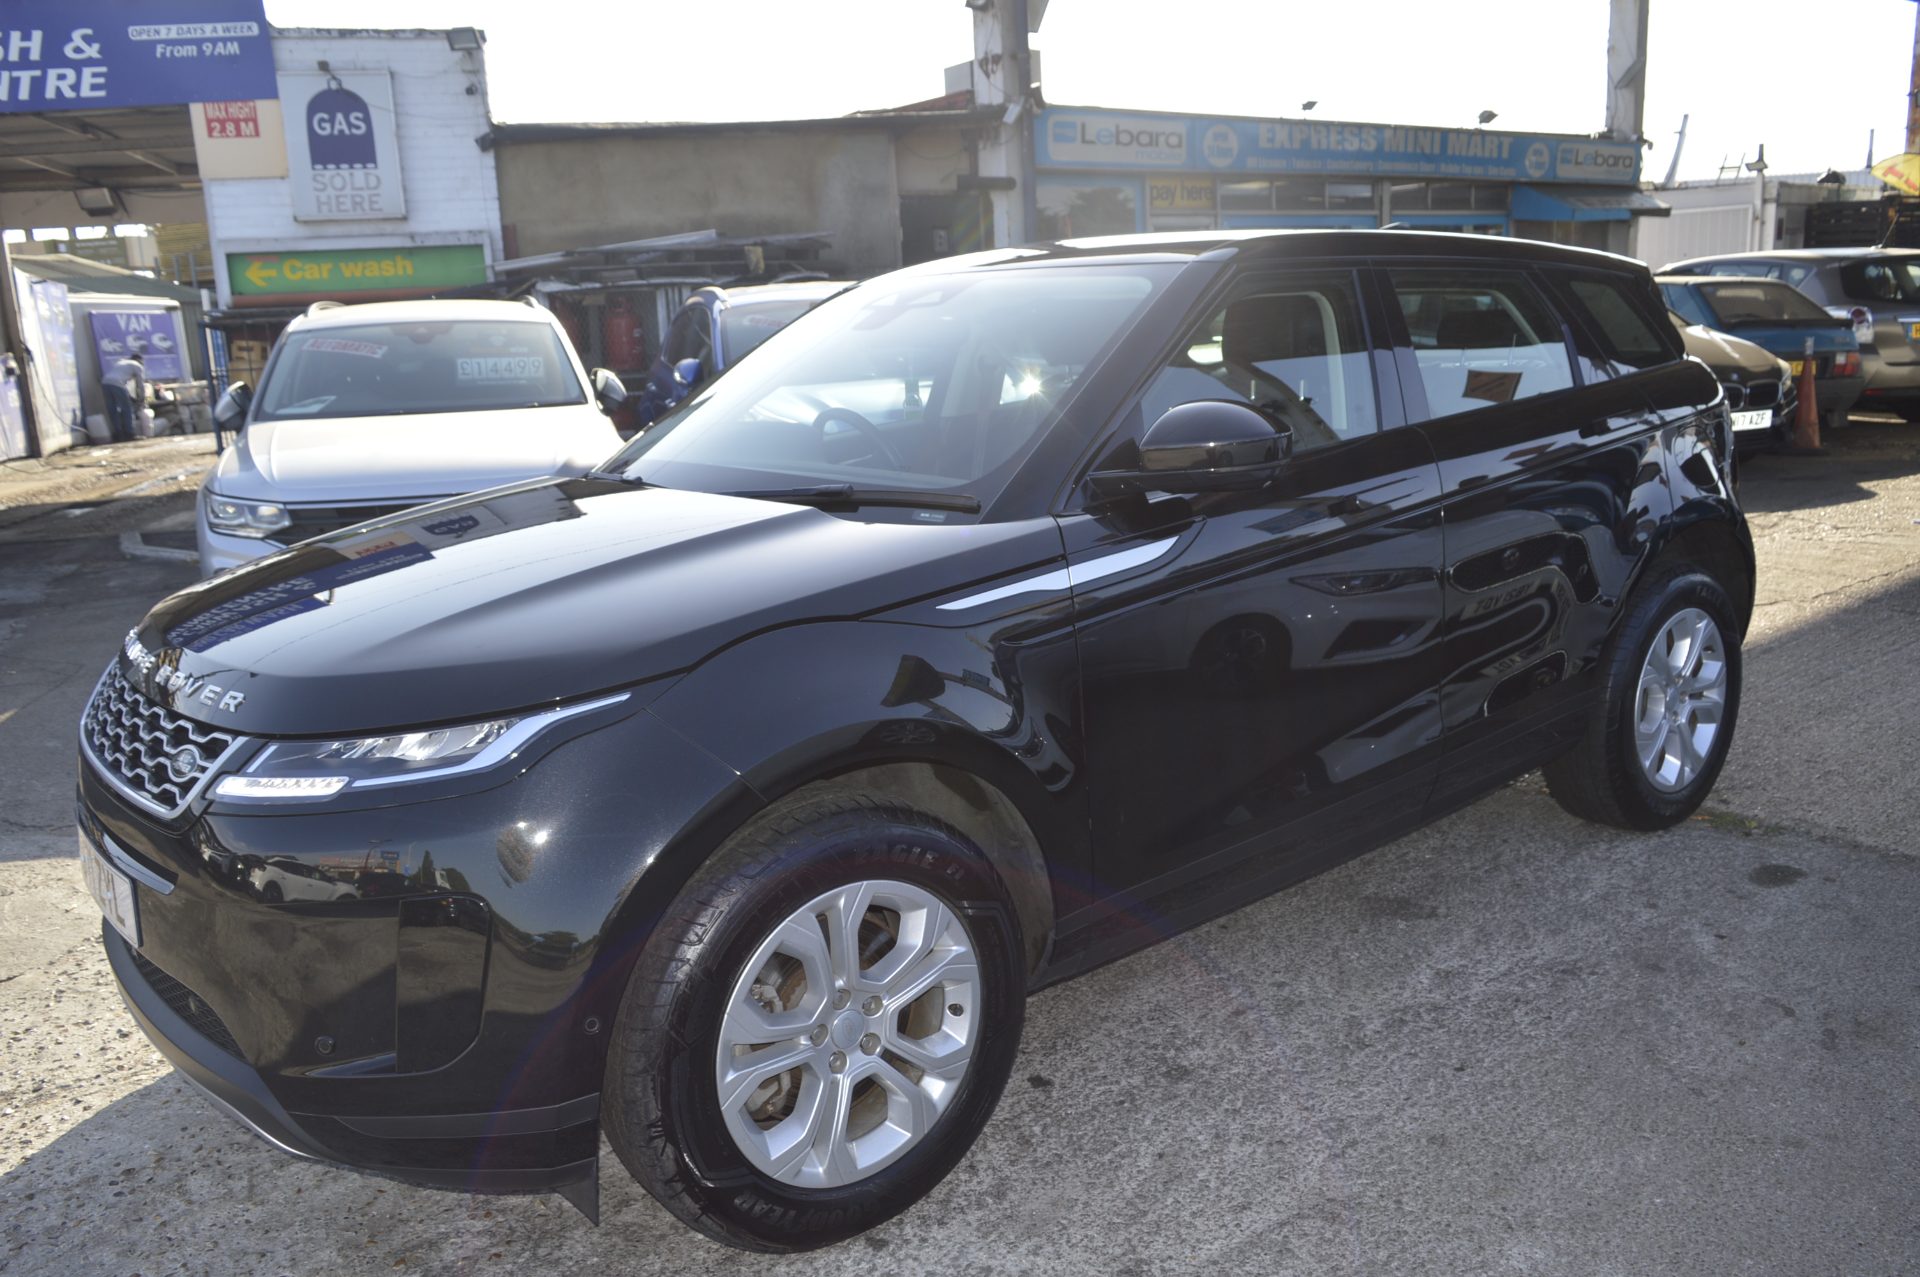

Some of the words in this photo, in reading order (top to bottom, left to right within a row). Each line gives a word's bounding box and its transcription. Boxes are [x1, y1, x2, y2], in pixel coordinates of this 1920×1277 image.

[130, 26, 163, 38] OPEN
[165, 26, 174, 37] 7
[176, 25, 206, 37] DAYS
[209, 25, 219, 36] A
[221, 23, 255, 36] WEEK
[63, 28, 103, 60] &
[155, 44, 198, 59] From
[202, 41, 241, 57] 9AM
[206, 103, 227, 119] MAX
[227, 102, 256, 119] HIGHT
[210, 121, 237, 137] 2.8
[239, 121, 257, 137] M
[312, 111, 368, 137] GAS
[1080, 121, 1184, 149] Lebara
[1258, 122, 1377, 151] EXPRESS
[1383, 126, 1443, 156] MINI
[1447, 132, 1514, 160] MART
[1574, 147, 1633, 169] Lebara
[312, 172, 382, 193] SOLD
[314, 193, 384, 214] HERE
[1150, 182, 1178, 205] pay
[1181, 182, 1215, 201] here
[283, 258, 331, 281] Car
[338, 255, 414, 279] wash
[115, 314, 152, 332] VAN
[459, 358, 543, 377] £14499
[154, 664, 246, 713] ROVER
